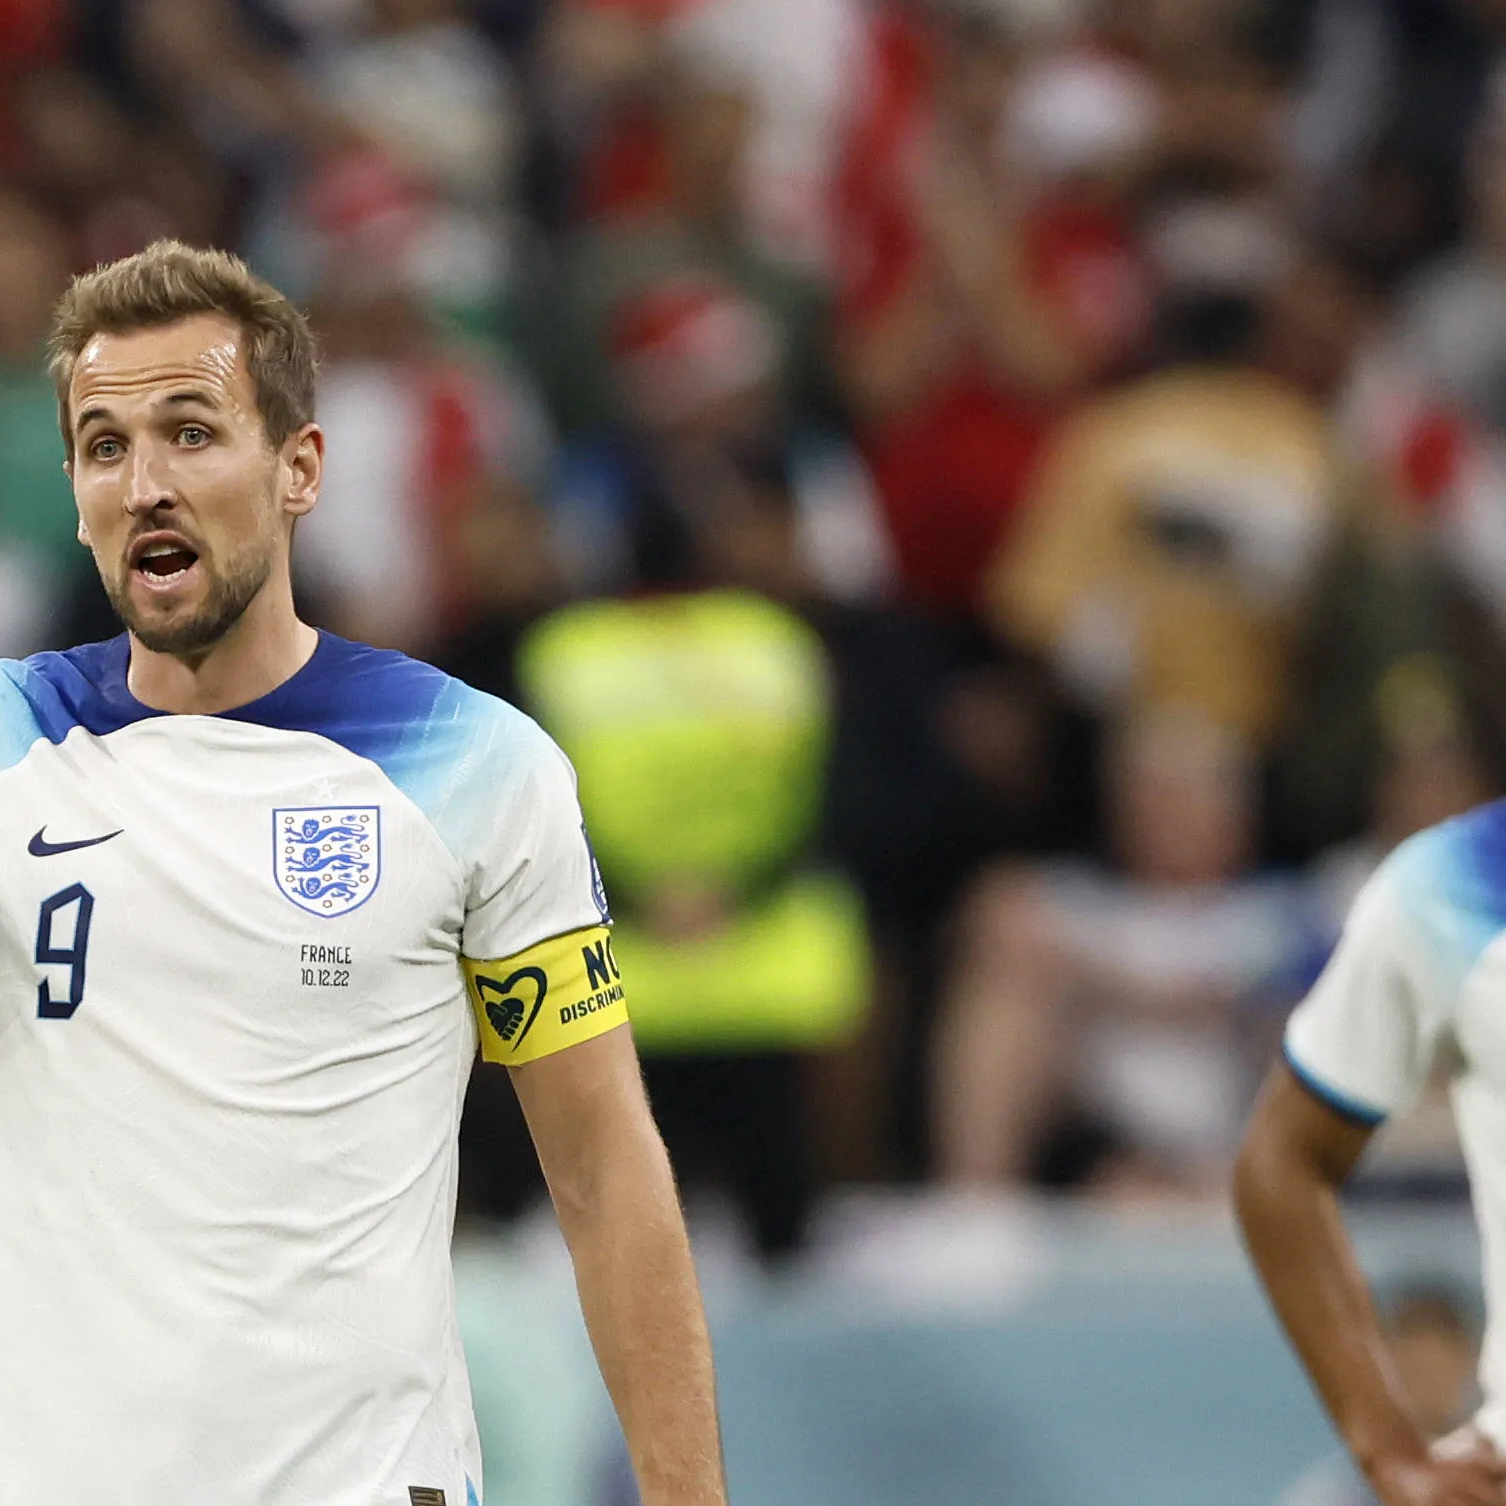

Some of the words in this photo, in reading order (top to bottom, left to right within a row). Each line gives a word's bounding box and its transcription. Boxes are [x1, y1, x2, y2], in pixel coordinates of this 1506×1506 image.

[36, 879, 95, 1020] 9
[301, 944, 352, 964] FRANCE
[301, 968, 350, 987] 10.12.22
